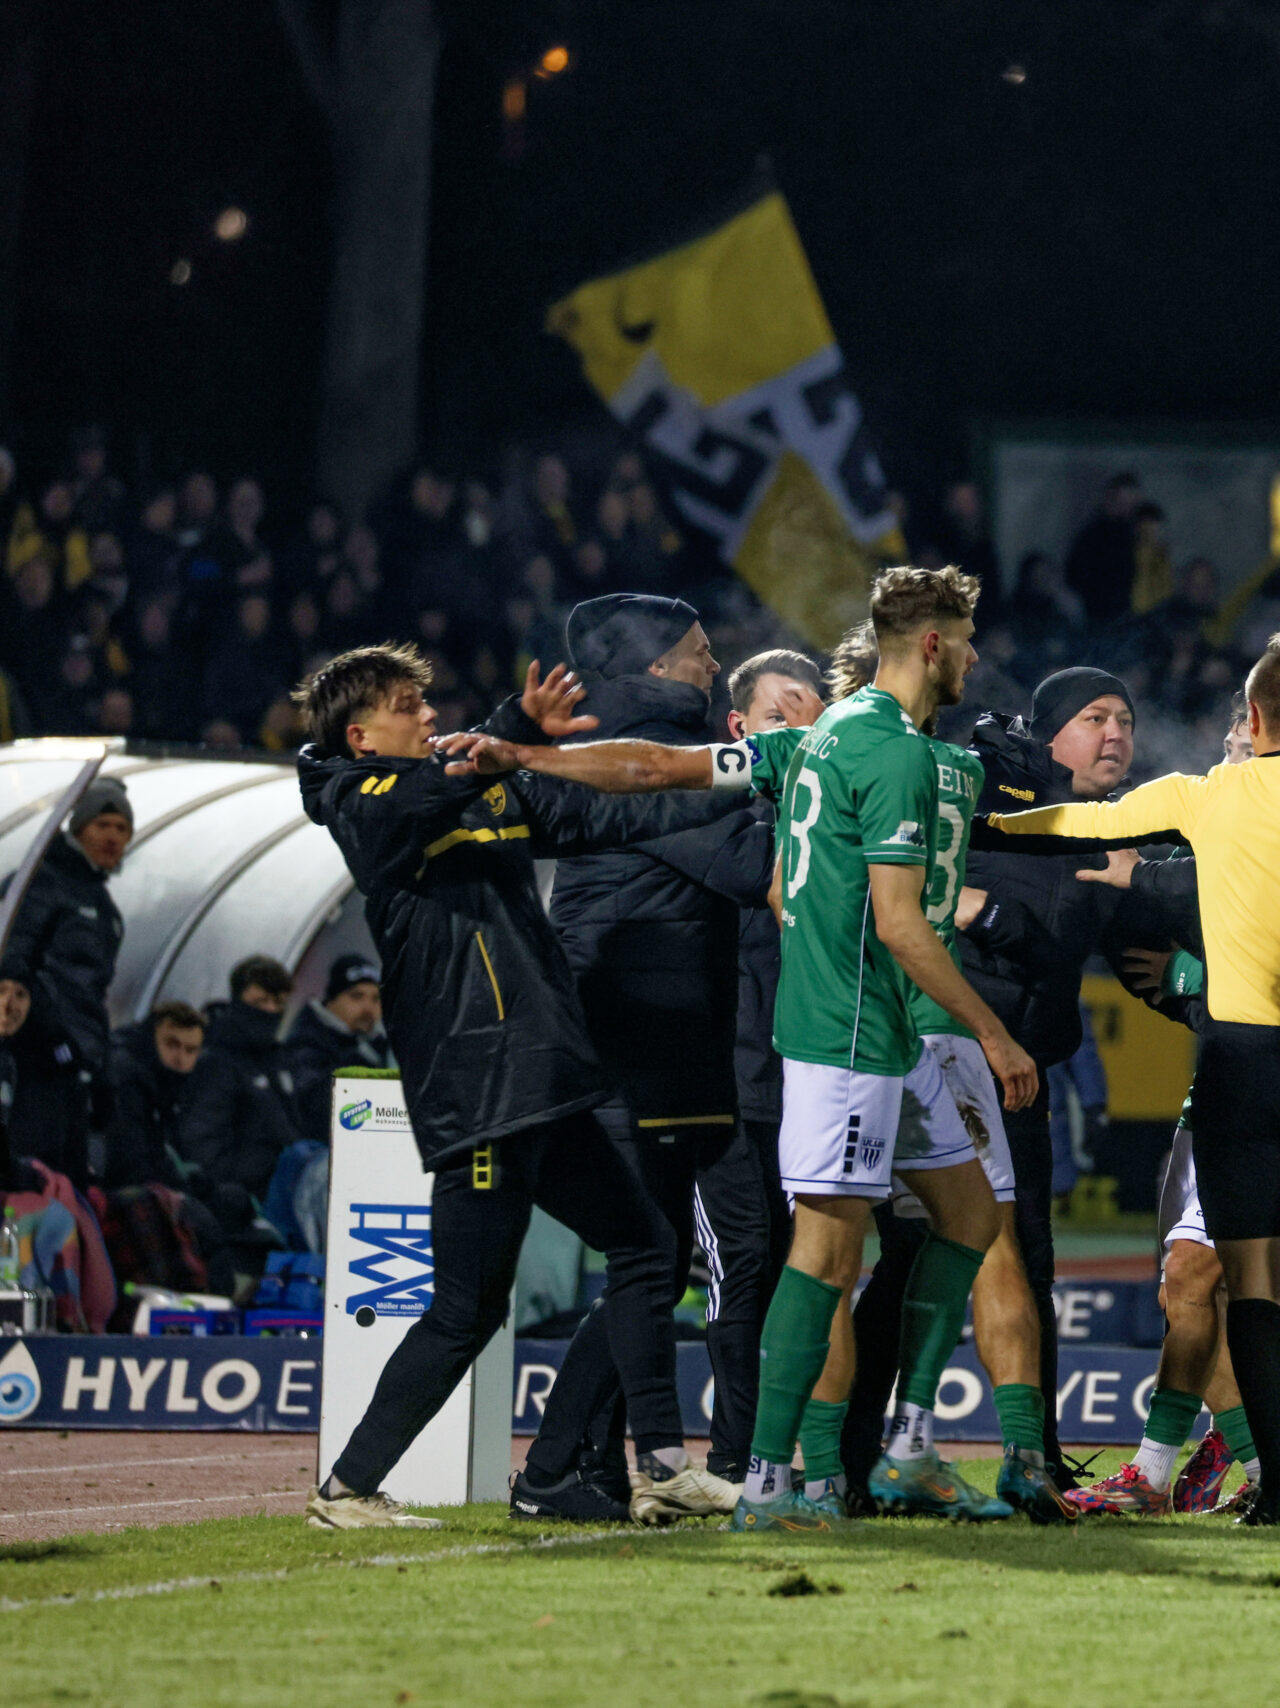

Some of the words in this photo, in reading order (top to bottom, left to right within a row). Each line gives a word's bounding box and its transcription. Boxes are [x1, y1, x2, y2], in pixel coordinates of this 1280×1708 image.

[717, 747, 747, 774] C
[937, 764, 974, 801] EIN
[62, 1357, 261, 1413] HYLO
